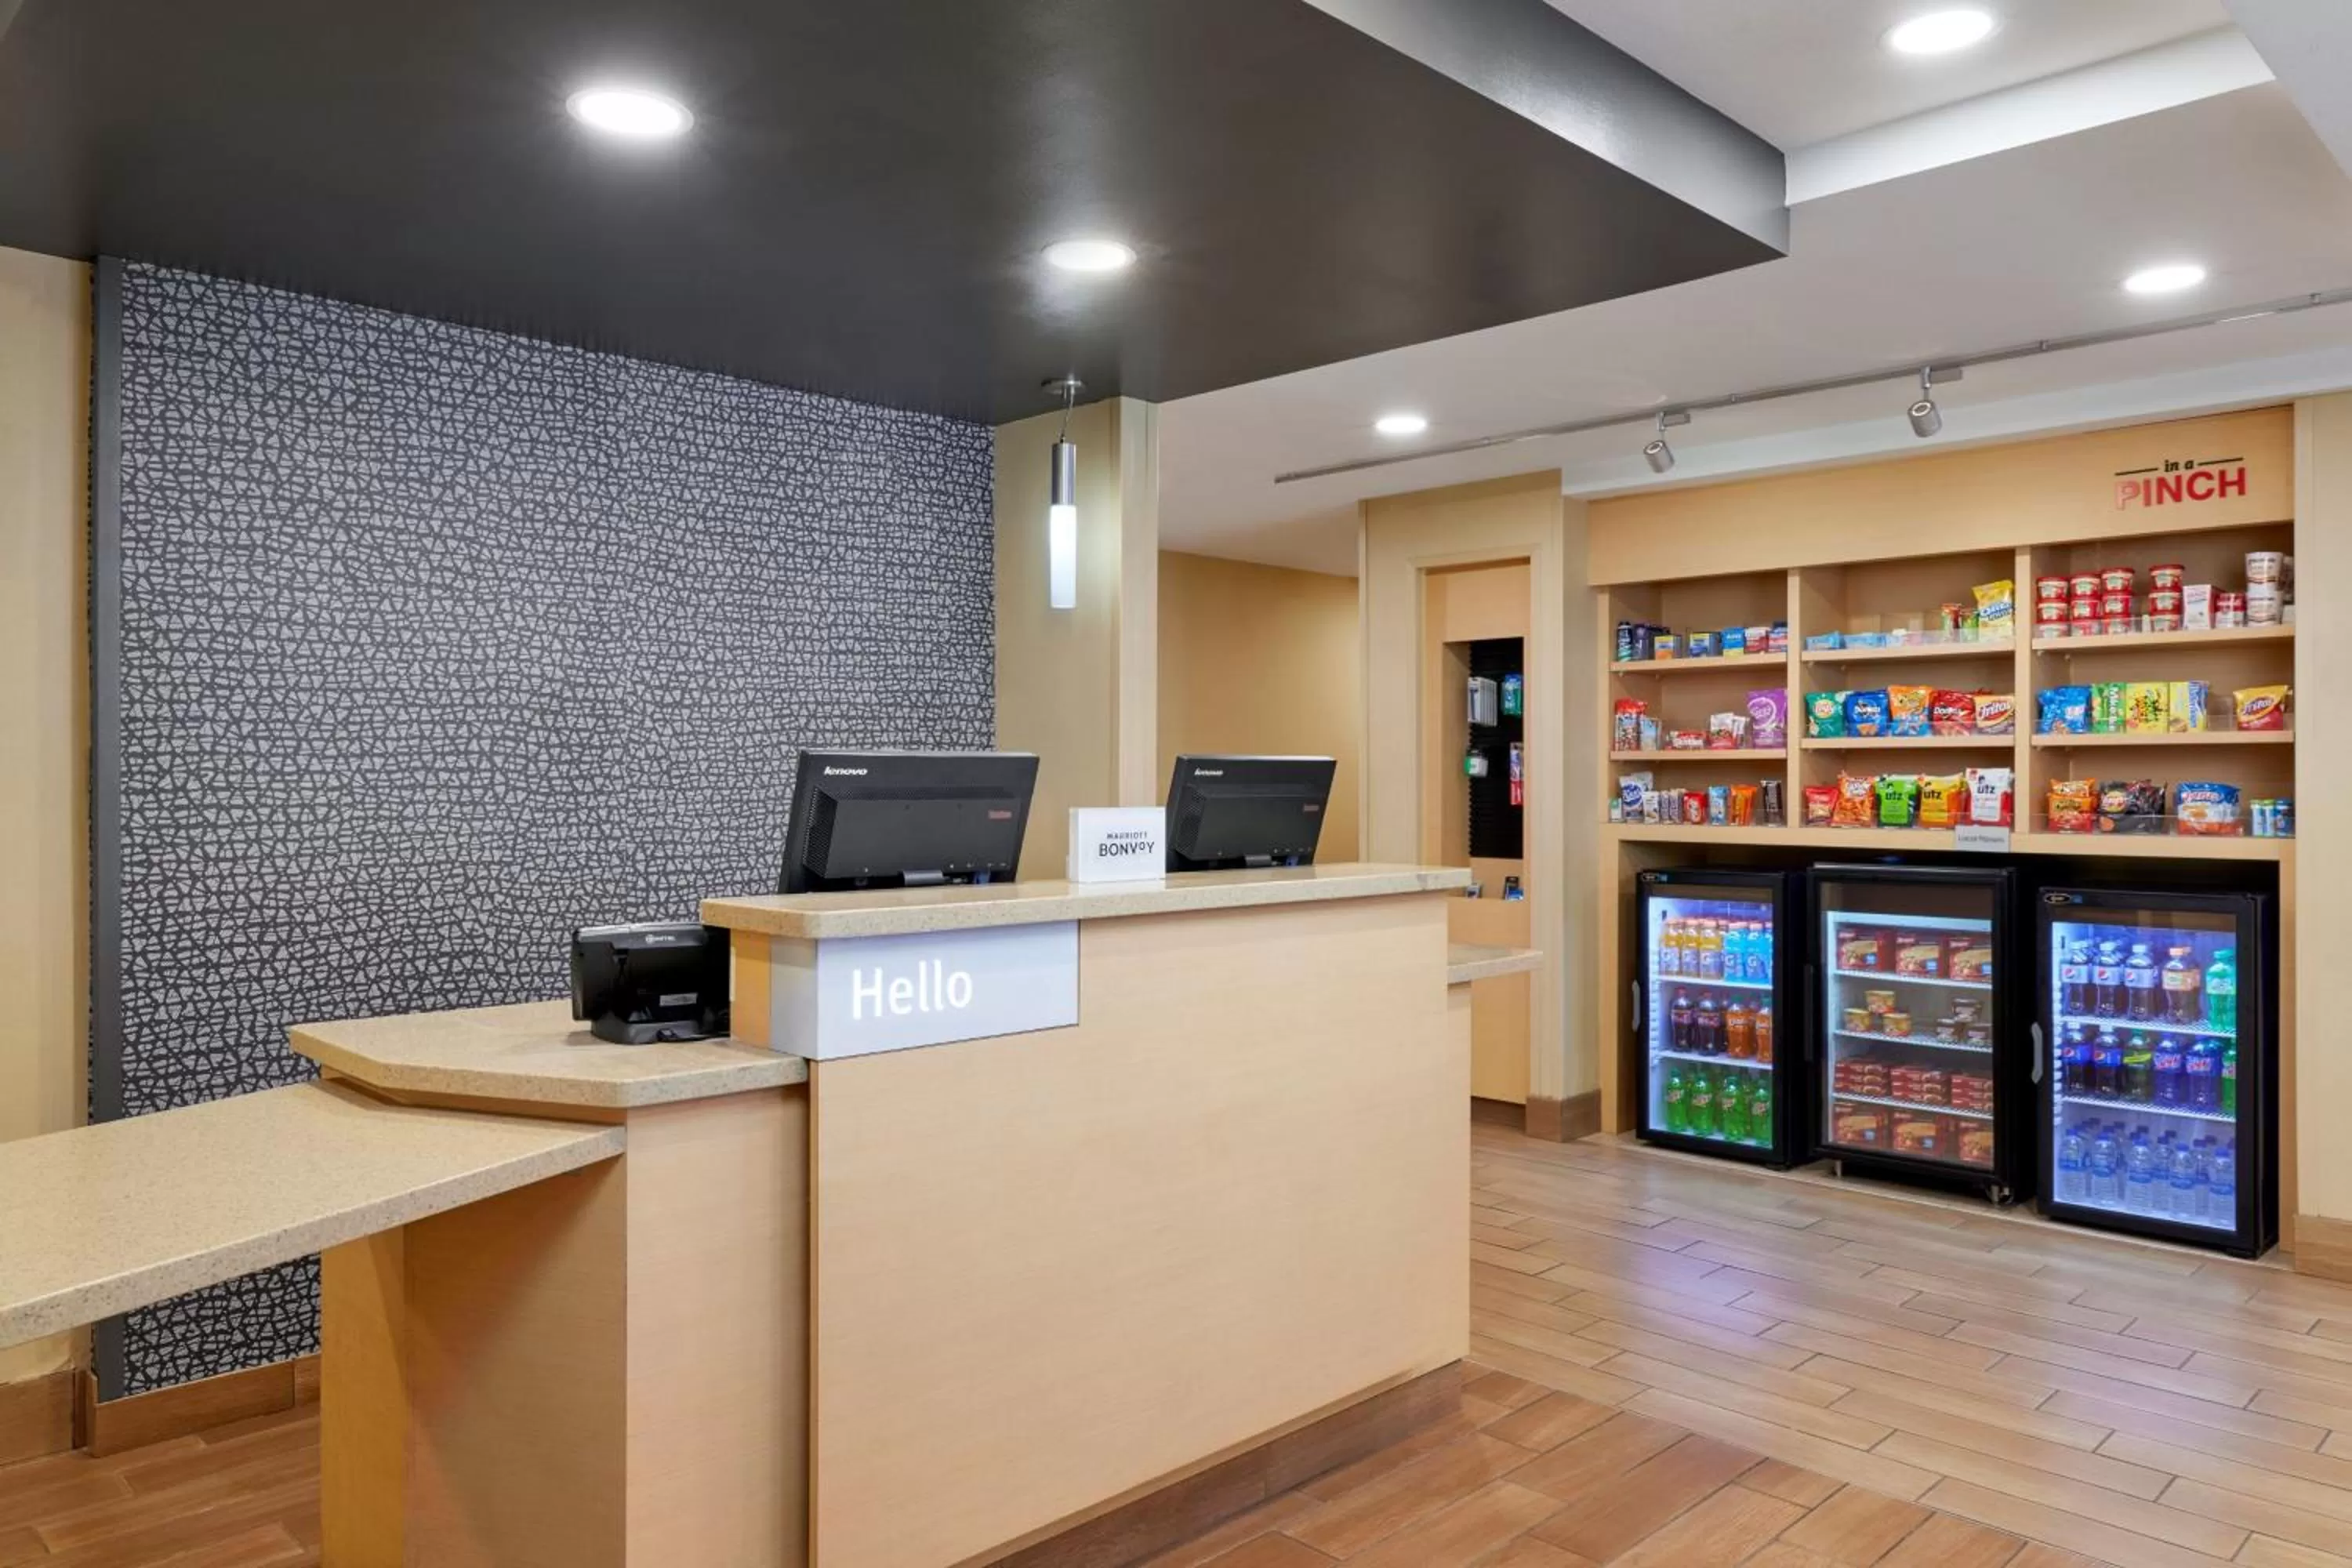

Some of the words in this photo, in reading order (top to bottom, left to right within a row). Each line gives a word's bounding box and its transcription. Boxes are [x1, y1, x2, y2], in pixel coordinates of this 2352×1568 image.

[2164, 459, 2180, 472] in
[2184, 459, 2194, 470] a
[2114, 466, 2246, 511] PINCH
[1923, 789, 1942, 800] utz
[1976, 784, 1995, 794] utz
[1106, 831, 1148, 840] MARRIOTT
[1098, 841, 1155, 857] BONVOY
[852, 959, 973, 1020] Hello
